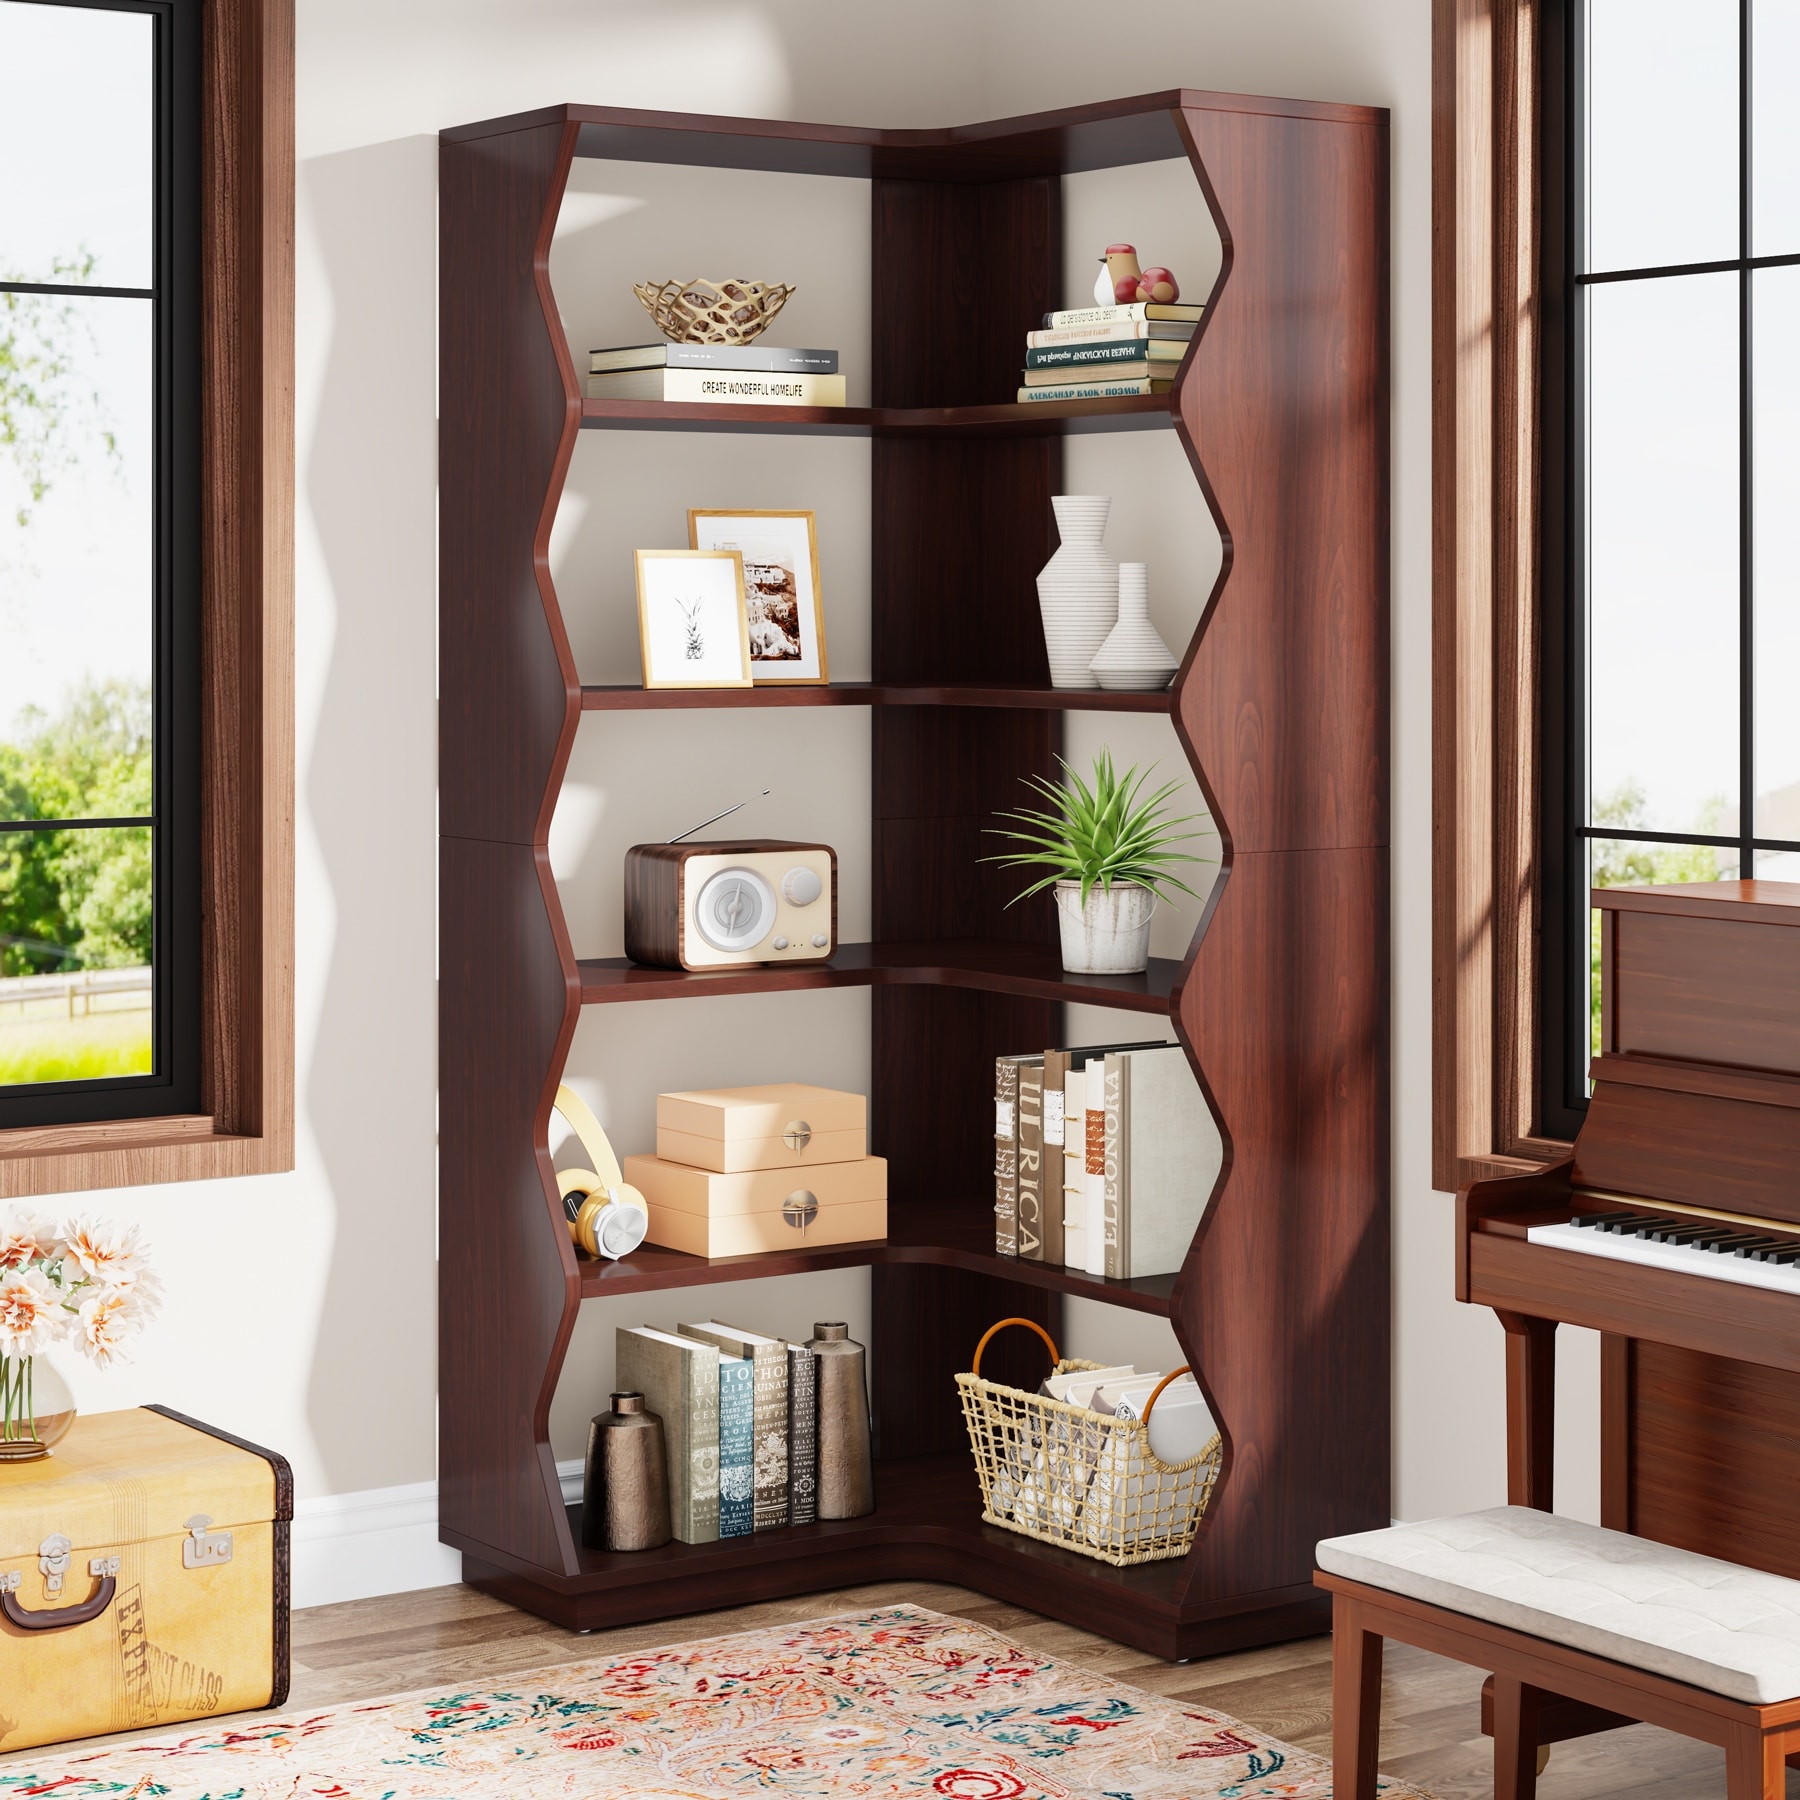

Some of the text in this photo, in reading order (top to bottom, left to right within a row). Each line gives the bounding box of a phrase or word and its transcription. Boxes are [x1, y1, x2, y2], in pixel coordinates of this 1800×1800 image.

[702, 381, 803, 397] CREATE WONDERFUL HOMELIFE
[1027, 386, 1140, 400] АЛЕКСАНДР БЛОК ПОЭМЫ
[1019, 1081, 1042, 1254] ULRICA
[1104, 1070, 1119, 1248] ELEONORA
[721, 1365, 754, 1383] TO
[118, 1598, 156, 1724] EXPR
